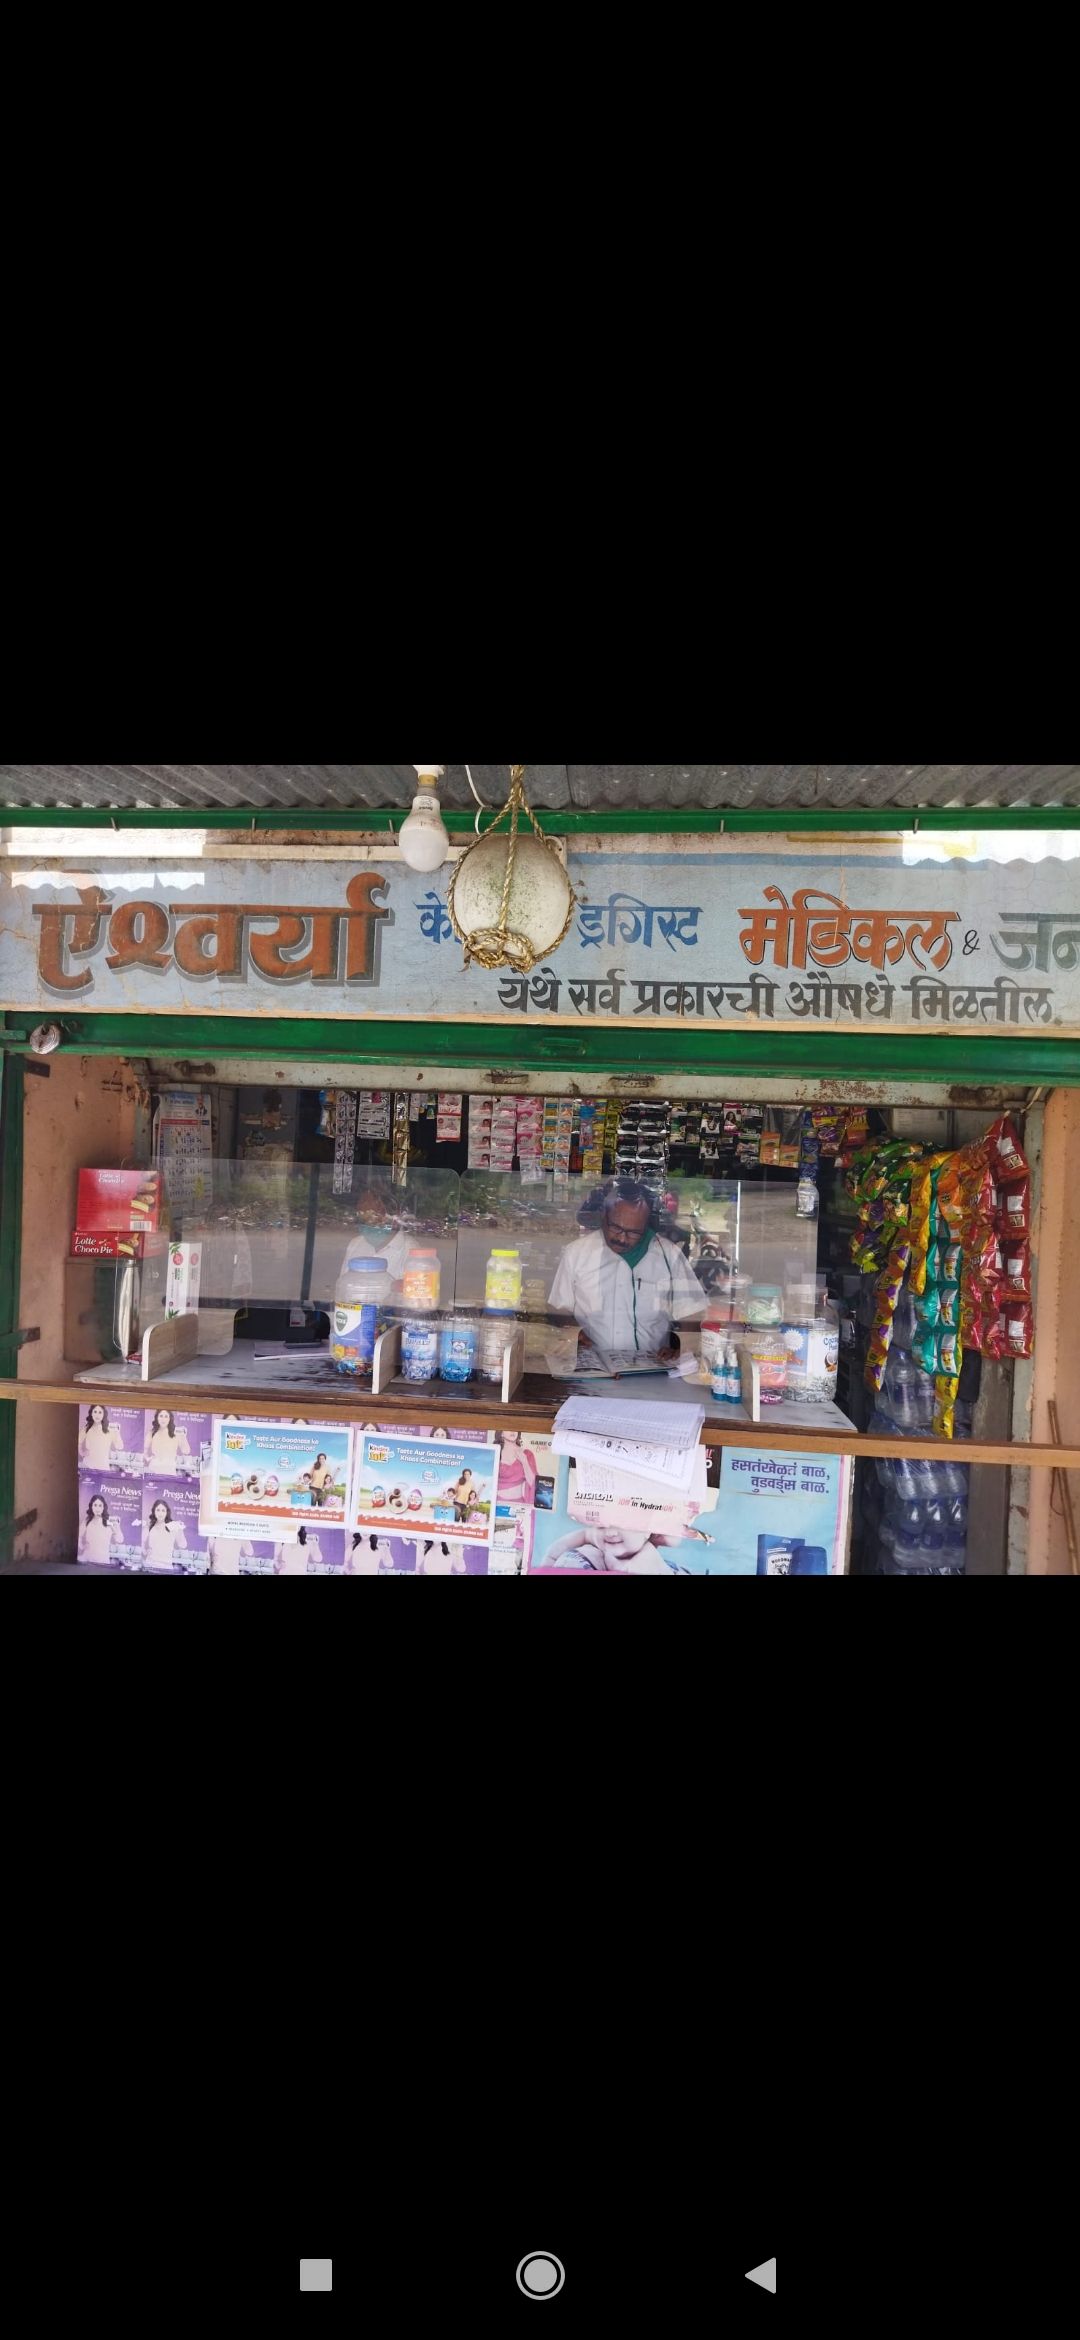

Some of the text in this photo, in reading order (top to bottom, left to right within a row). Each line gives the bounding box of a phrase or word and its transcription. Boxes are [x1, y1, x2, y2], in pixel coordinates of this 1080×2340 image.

[576, 892, 703, 952] ड्रगिस्ट
[737, 885, 961, 972] मेडिकल
[962, 929, 980, 955] &
[497, 967, 562, 1013] येथे
[568, 968, 627, 1016] सर्व
[630, 972, 781, 1018] प्रकारची
[785, 971, 896, 1019] औषधे
[75, 1236, 97, 1245] Lotte
[74, 1245, 113, 1254] Choco Pie
[397, 1447, 413, 1455] Taste
[426, 1450, 455, 1459] Goodness
[731, 1459, 830, 1480] हसतंखेळतं बाळ,
[100, 1484, 142, 1496] Prega News
[801, 1481, 829, 1494] बाळ.
[163, 1489, 200, 1501] Prega New
